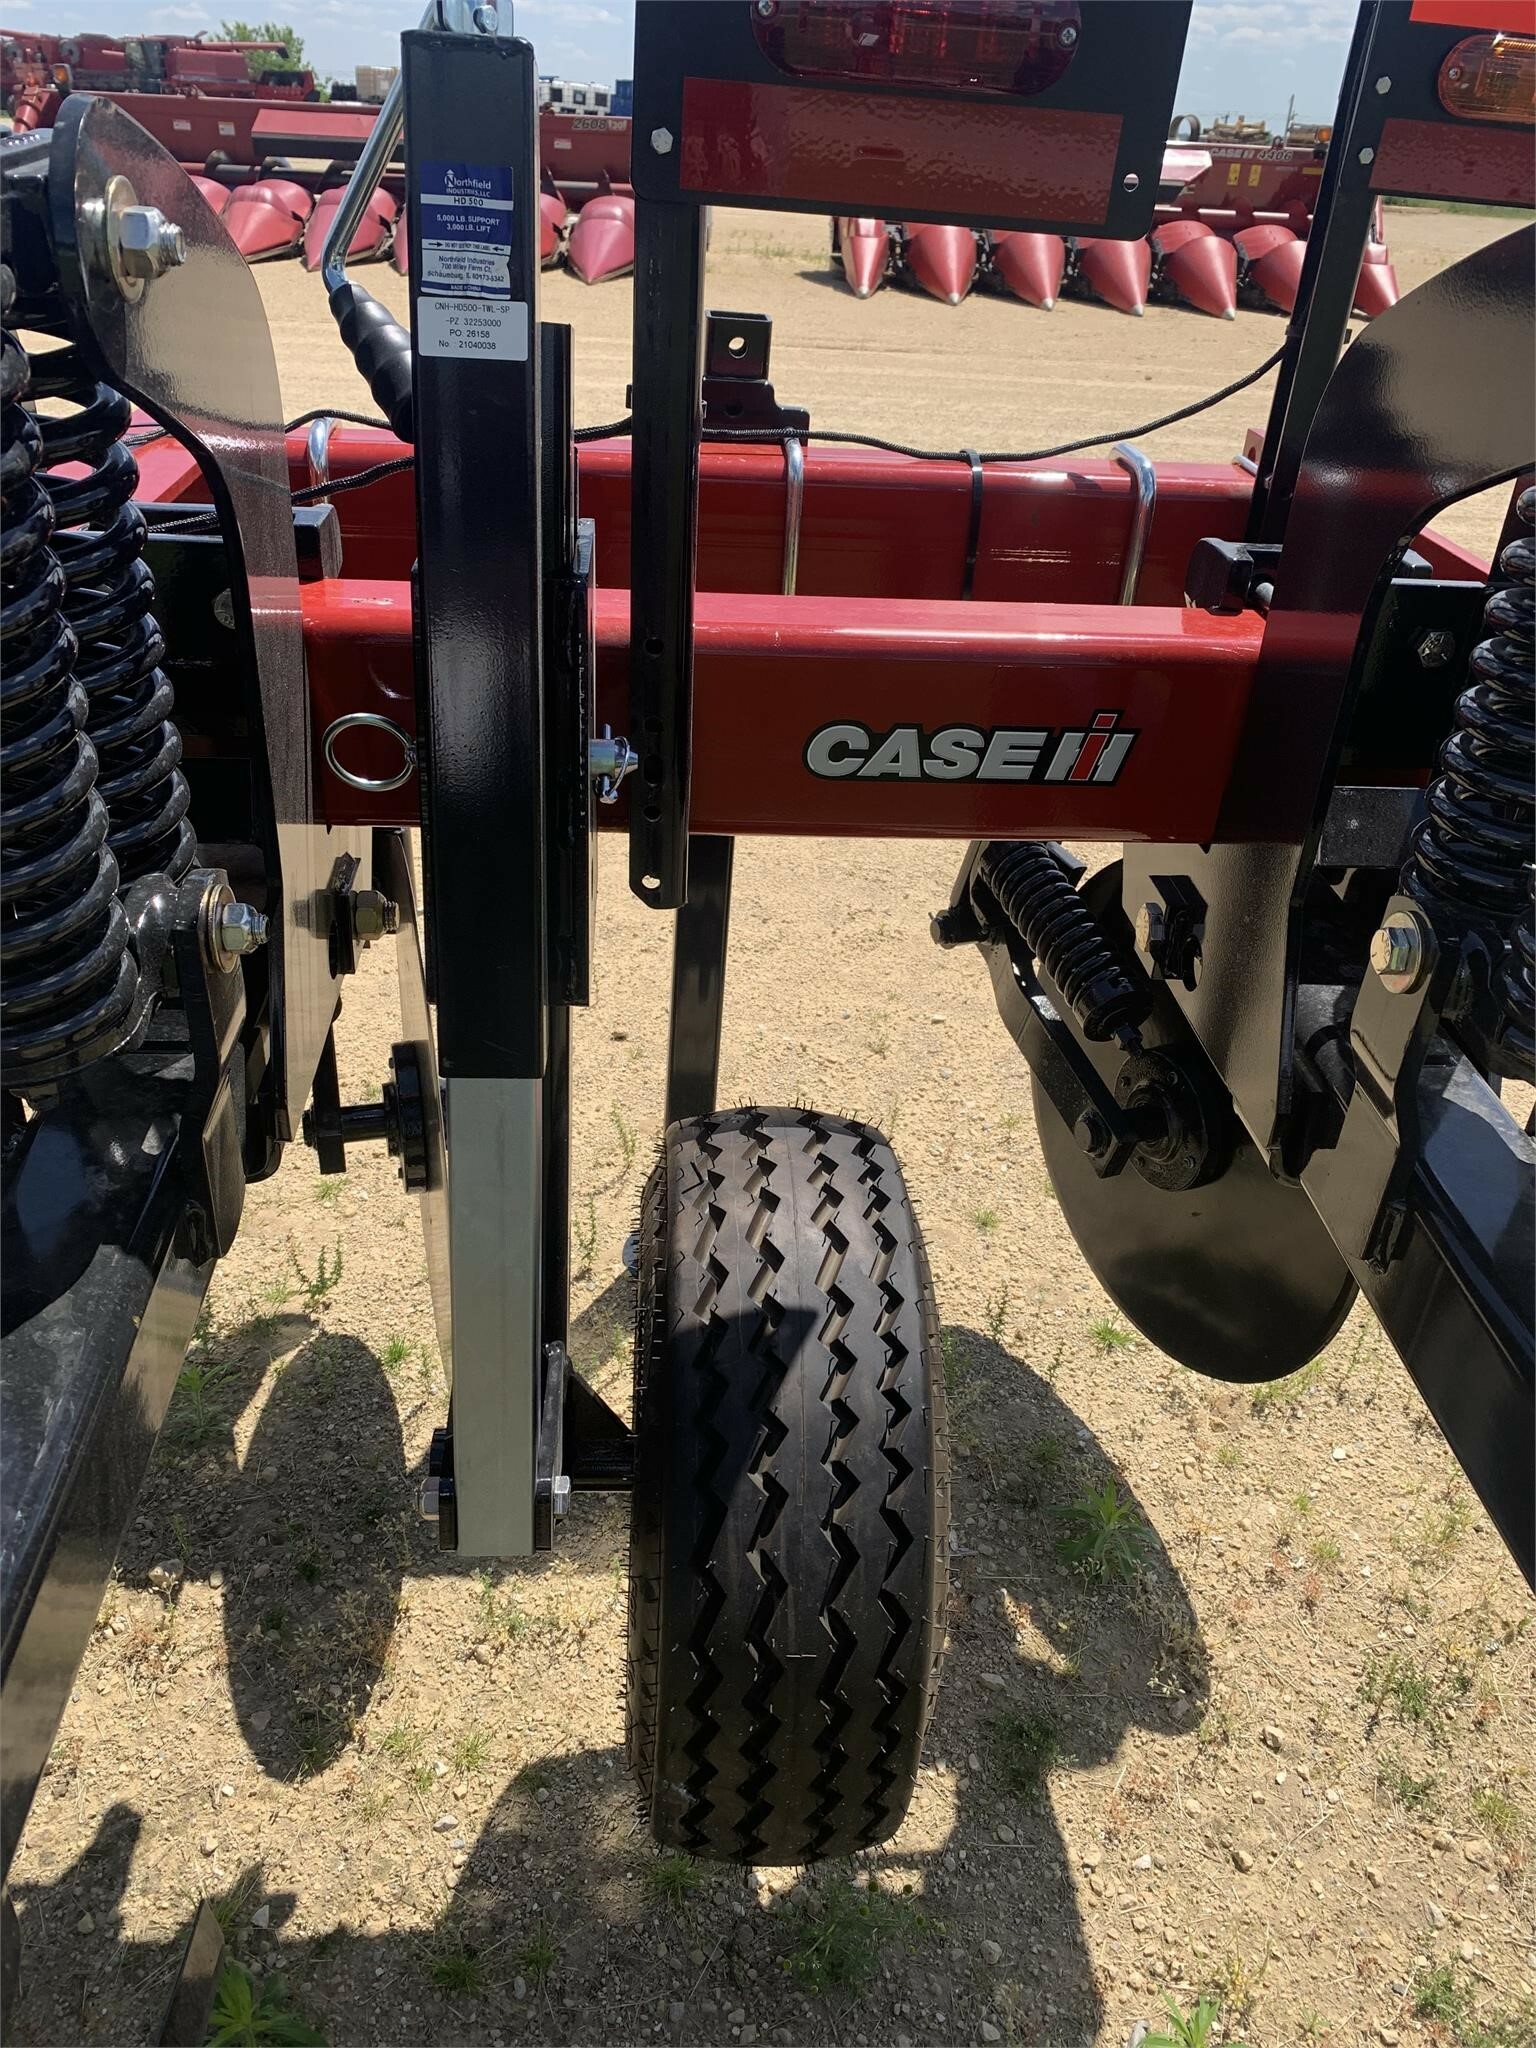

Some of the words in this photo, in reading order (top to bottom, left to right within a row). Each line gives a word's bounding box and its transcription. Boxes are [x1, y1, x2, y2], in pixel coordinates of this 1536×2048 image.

[1211, 148, 1241, 158] CASE
[1257, 149, 1294, 161] 4406
[444, 170, 491, 190] Northfield
[454, 196, 467, 205] HD
[468, 197, 484, 206] 500
[468, 216, 500, 226] SUPPORT
[446, 223, 464, 231] 3,000
[476, 225, 491, 233] LIFT
[467, 256, 495, 266] Industries
[468, 264, 483, 272] Farm
[434, 302, 511, 314] CNH-HD500-TWL-SP
[463, 317, 502, 327] 32253000
[466, 329, 490, 339] 26158
[459, 340, 497, 350] 21040038
[806, 724, 1049, 780] CASE
